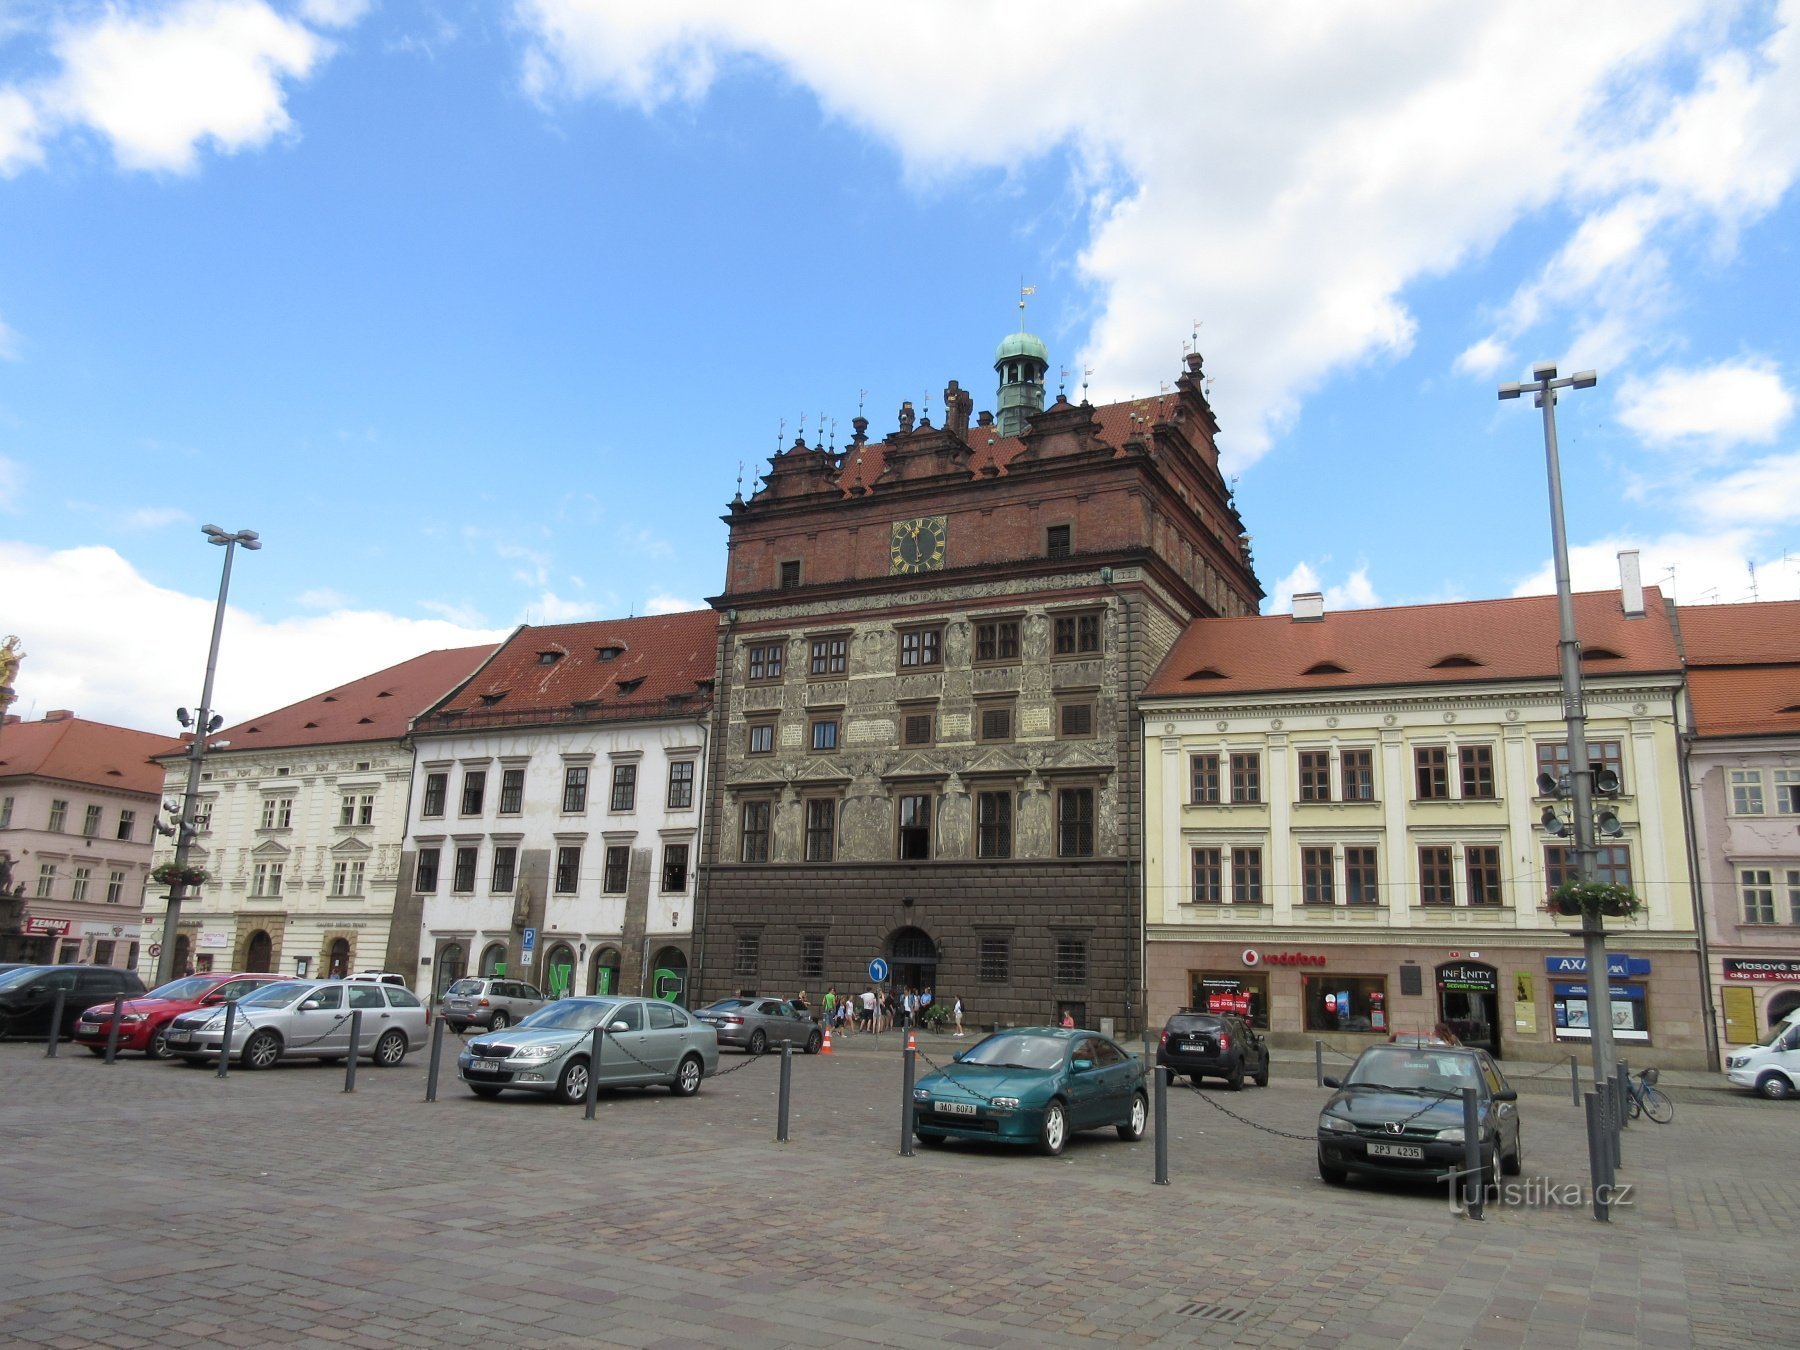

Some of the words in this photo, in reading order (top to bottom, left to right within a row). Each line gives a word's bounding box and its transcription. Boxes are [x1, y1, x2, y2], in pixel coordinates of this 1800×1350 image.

[30, 918, 67, 929] ZEMAN
[525, 931, 533, 943] P
[1262, 952, 1326, 966] vodafone
[1608, 965, 1625, 974] AXA
[1735, 962, 1787, 971] vlasové
[1374, 1144, 1391, 1155] 2P3
[1397, 1147, 1420, 1158] 4235
